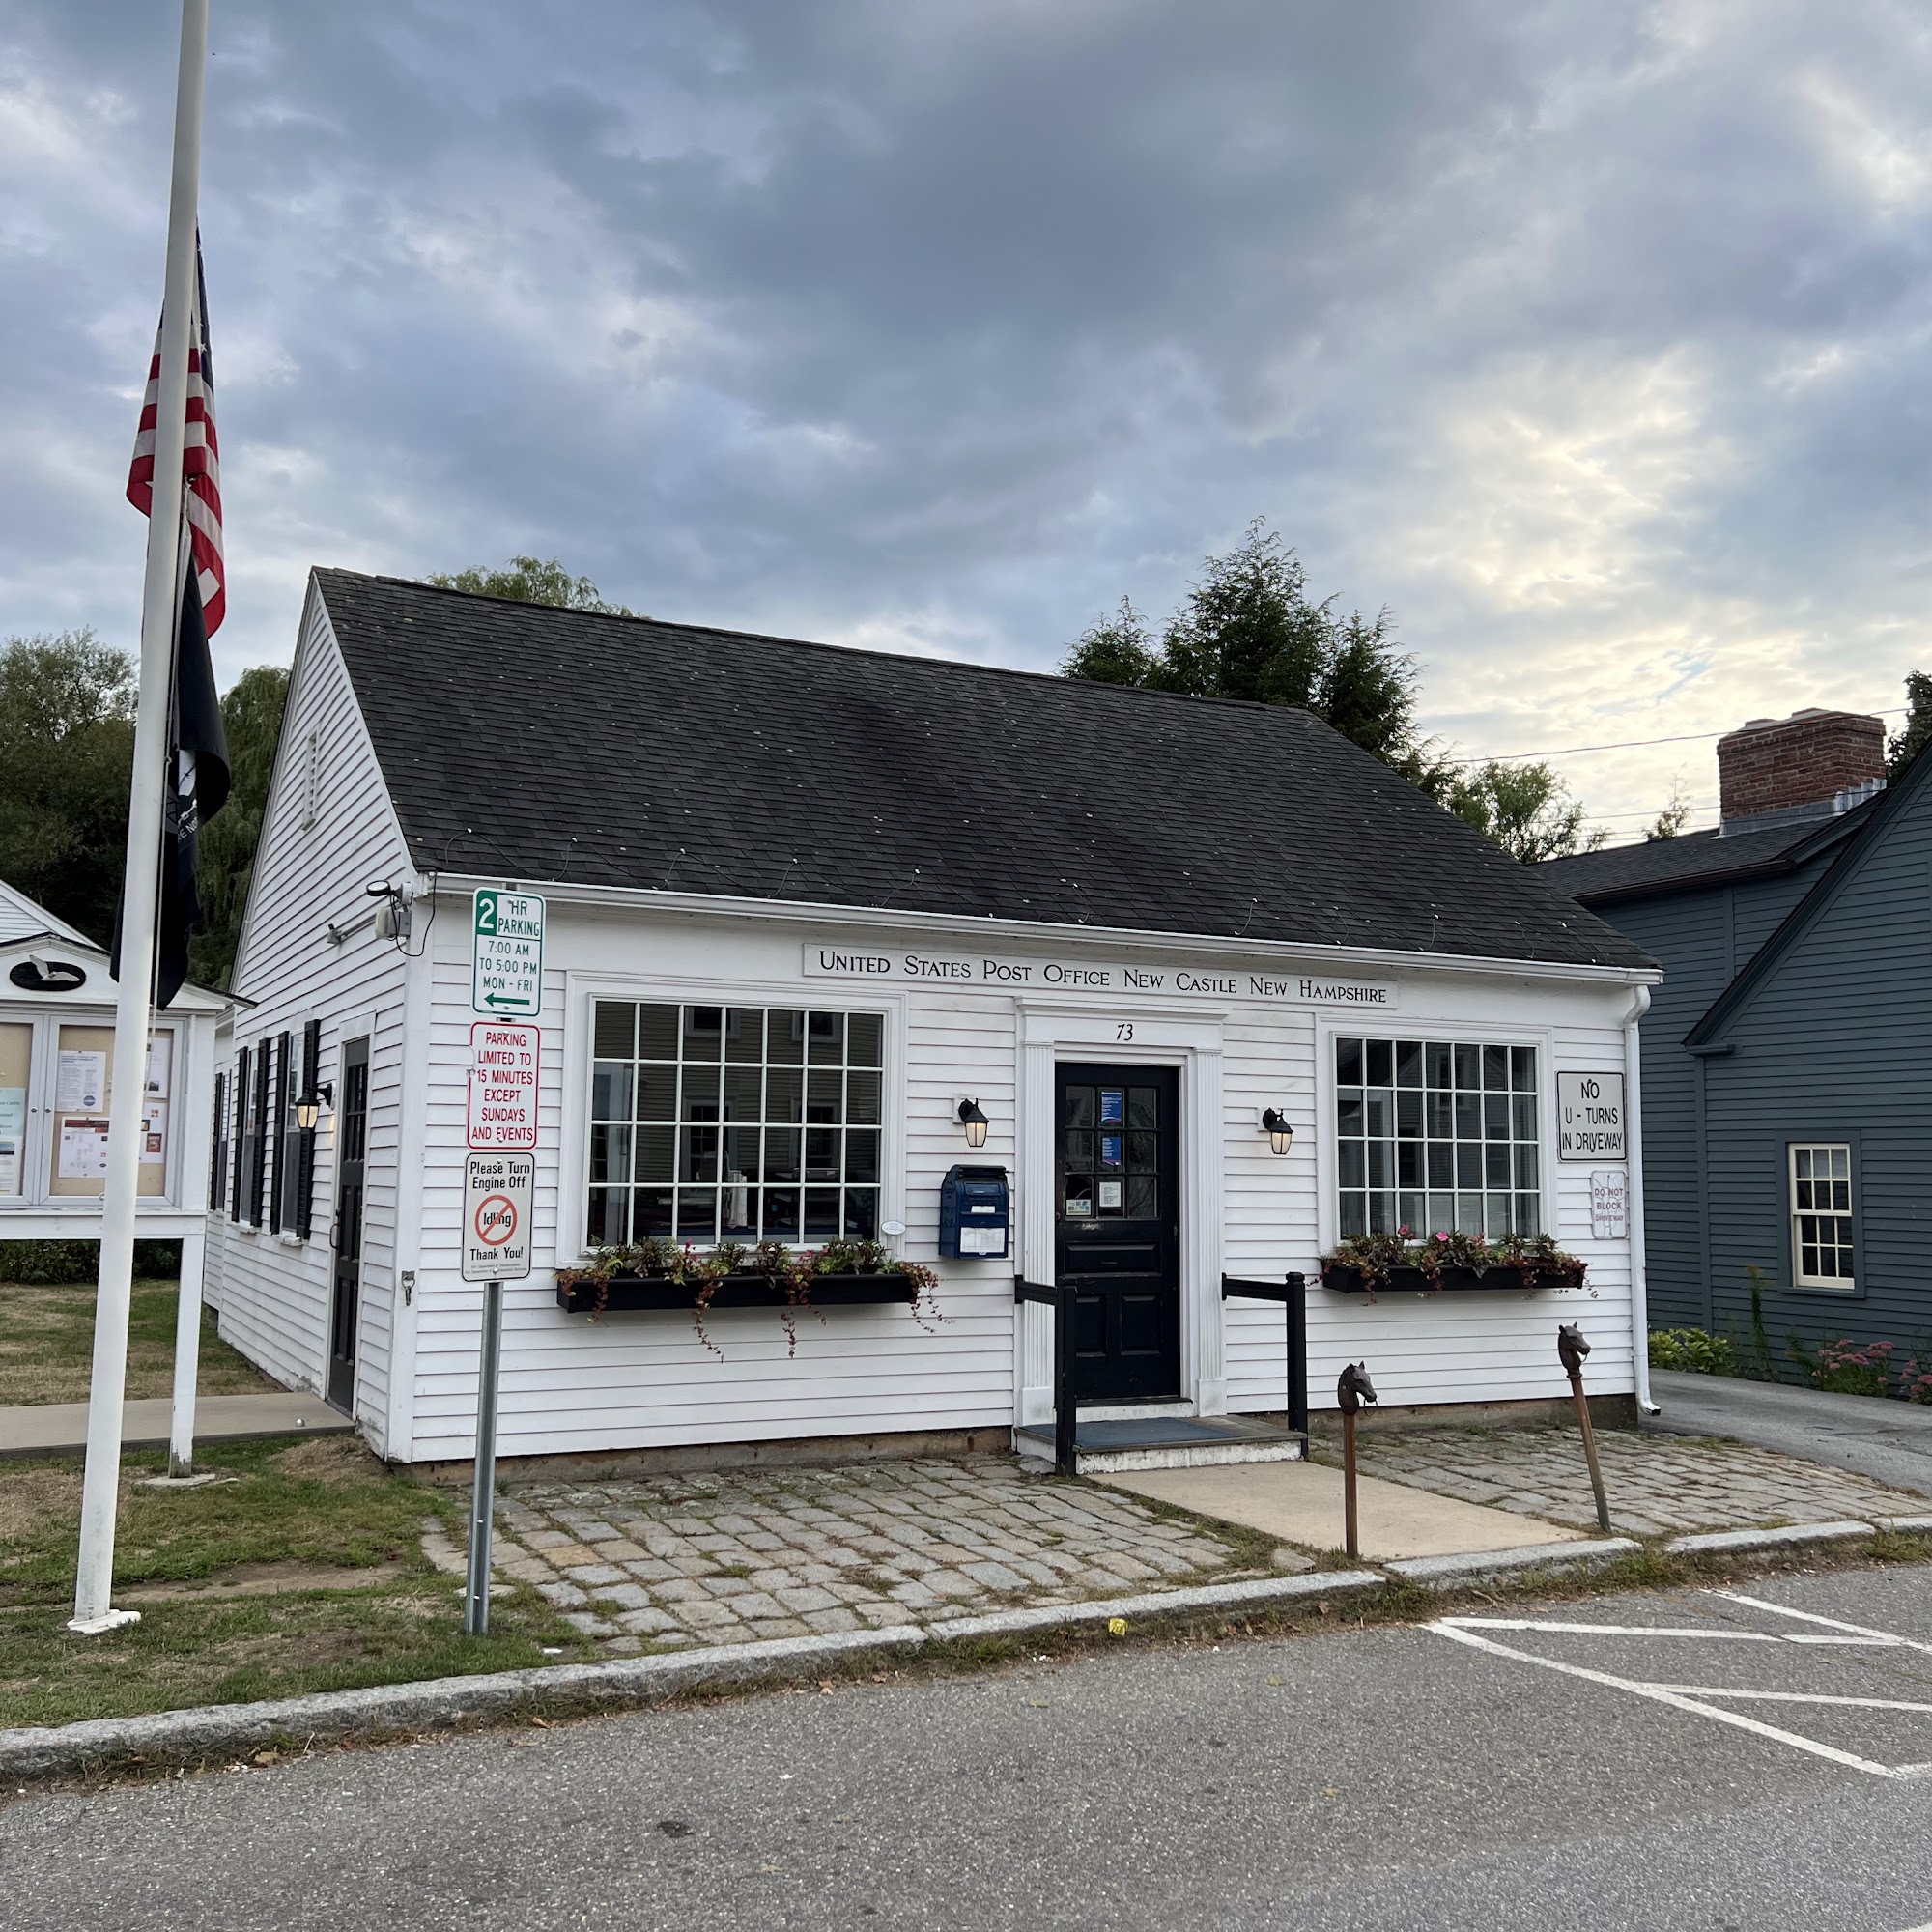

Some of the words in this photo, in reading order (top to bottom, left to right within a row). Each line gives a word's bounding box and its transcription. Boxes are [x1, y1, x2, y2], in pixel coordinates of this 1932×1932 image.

[478, 897, 495, 929] 2
[510, 900, 527, 916] HR
[497, 917, 540, 937] PARKING
[488, 941, 511, 954] 7:00
[515, 944, 529, 956] AM
[479, 957, 492, 971] TO
[496, 959, 519, 973] 5:00
[523, 961, 537, 975] PM
[483, 976, 505, 990] MON
[517, 979, 532, 992] FRI
[819, 951, 891, 974] UNITED
[903, 955, 972, 979] STATES
[983, 959, 1032, 981] POST
[1043, 964, 1110, 986] OFFICE
[1124, 969, 1164, 989] NEW
[1176, 973, 1237, 994] CASTLE
[1249, 976, 1288, 996] NEW
[1299, 980, 1387, 1004] HAMPSHIRE
[486, 1031, 526, 1047] PARKING
[1117, 1023, 1133, 1041] 73
[478, 1050, 515, 1065] LIMITED
[519, 1052, 532, 1065] TO
[477, 1069, 487, 1083] 15
[491, 1069, 533, 1085] MINUTES
[484, 1088, 521, 1102] EXCEPT
[1580, 1081, 1600, 1099] NO
[481, 1107, 526, 1122] SUNDAYS
[1565, 1107, 1572, 1124] U
[1585, 1107, 1618, 1125] TURNS
[471, 1126, 492, 1140] AND
[496, 1126, 533, 1141] EVENTS
[1562, 1132, 1572, 1150] IN
[1576, 1132, 1623, 1151] DRIVEWAY
[469, 1161, 503, 1175] Please
[508, 1161, 530, 1174] Turn
[472, 1176, 505, 1192] Engine
[508, 1176, 526, 1189] Off
[1594, 1188, 1605, 1197] DO
[1608, 1188, 1624, 1197] NOT
[1596, 1202, 1622, 1210] BLOCK
[469, 1247, 498, 1261] Thank
[504, 1246, 524, 1259] You!
